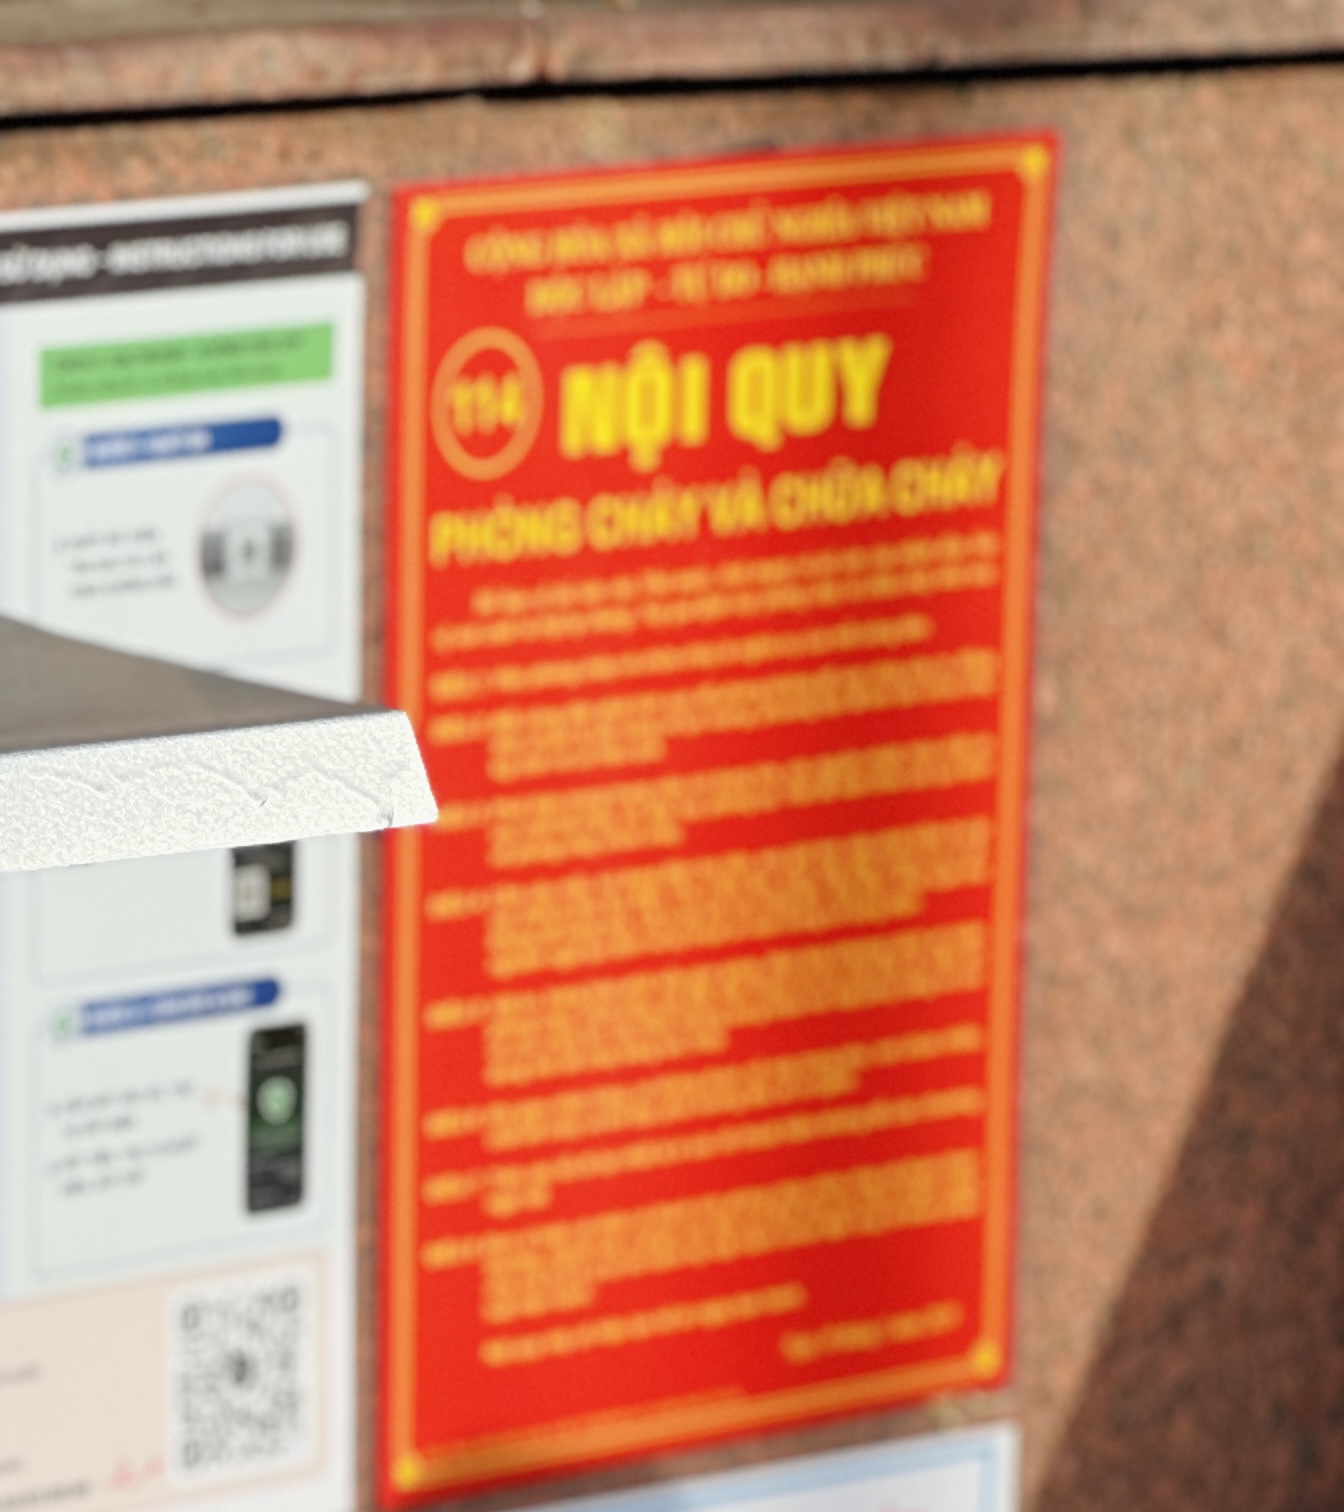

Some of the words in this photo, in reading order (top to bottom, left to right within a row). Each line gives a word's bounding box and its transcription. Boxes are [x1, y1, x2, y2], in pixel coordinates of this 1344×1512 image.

[559, 338, 710, 474] NỘI
[725, 332, 893, 453] QUY
[427, 491, 584, 570] PHÒNG
[586, 473, 701, 553] CHÁY
[708, 462, 769, 537] VÀ
